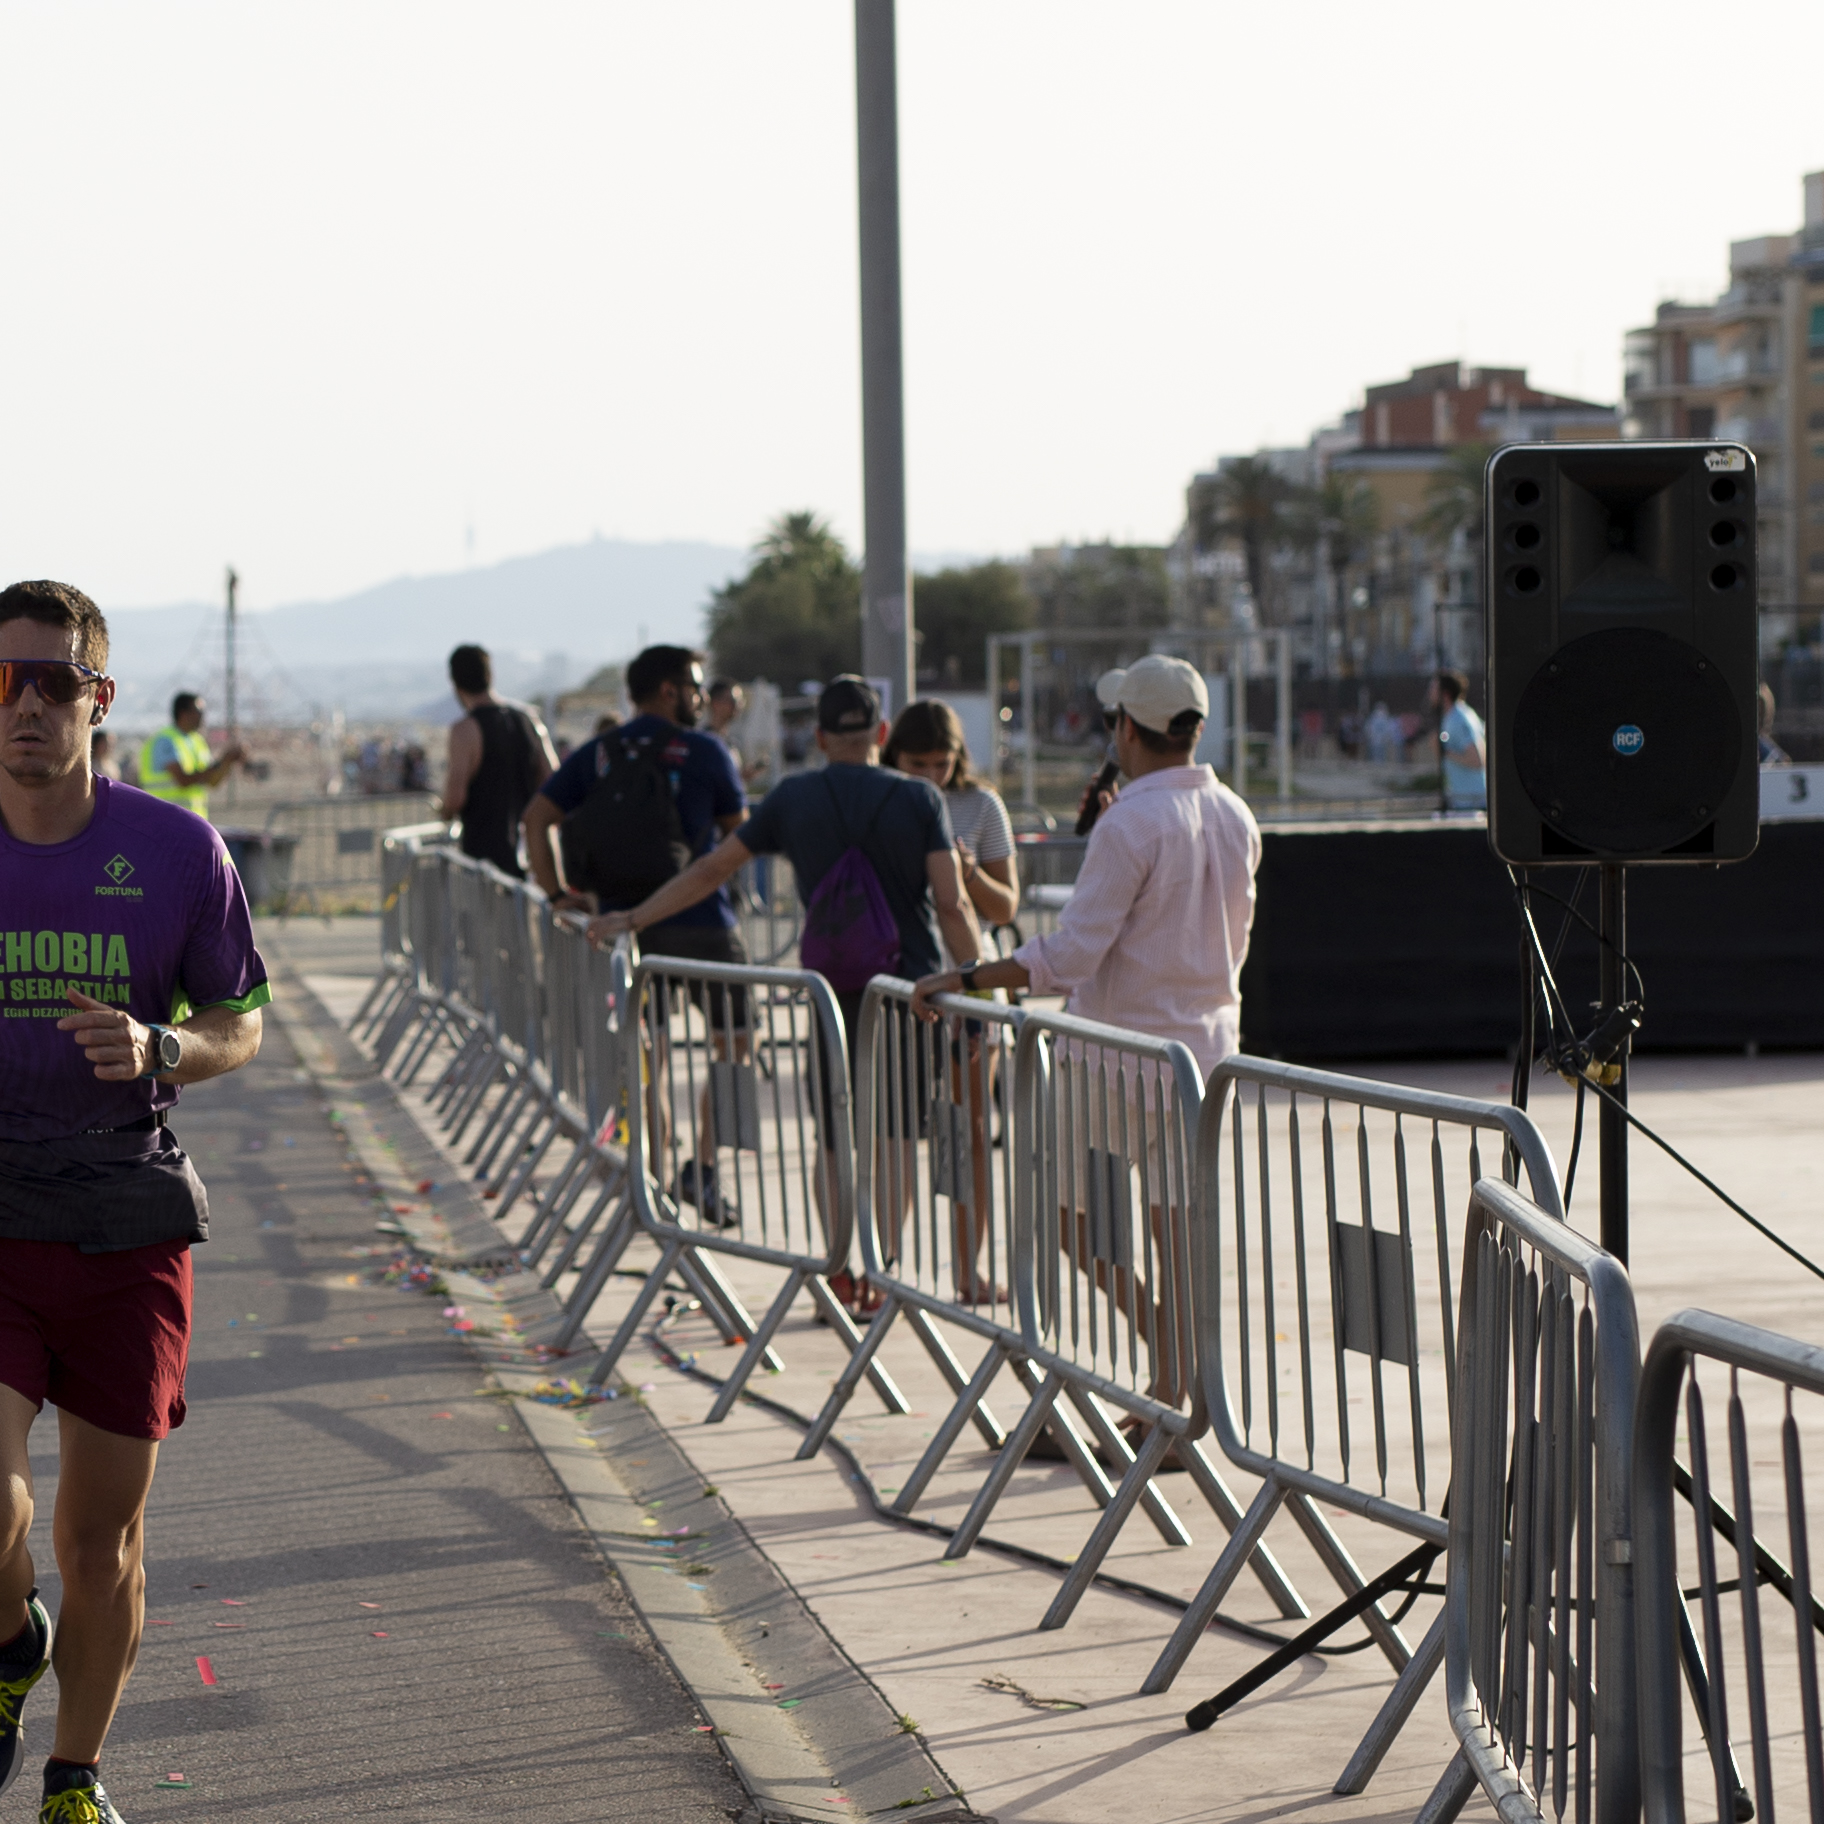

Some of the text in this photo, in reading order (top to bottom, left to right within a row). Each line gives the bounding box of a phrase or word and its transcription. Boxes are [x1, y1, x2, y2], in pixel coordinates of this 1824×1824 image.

[1616, 732, 1642, 746] RCF
[1788, 773, 1808, 803] 3
[94, 885, 144, 897] FORTUNA
[3, 1007, 31, 1019] EGIN
